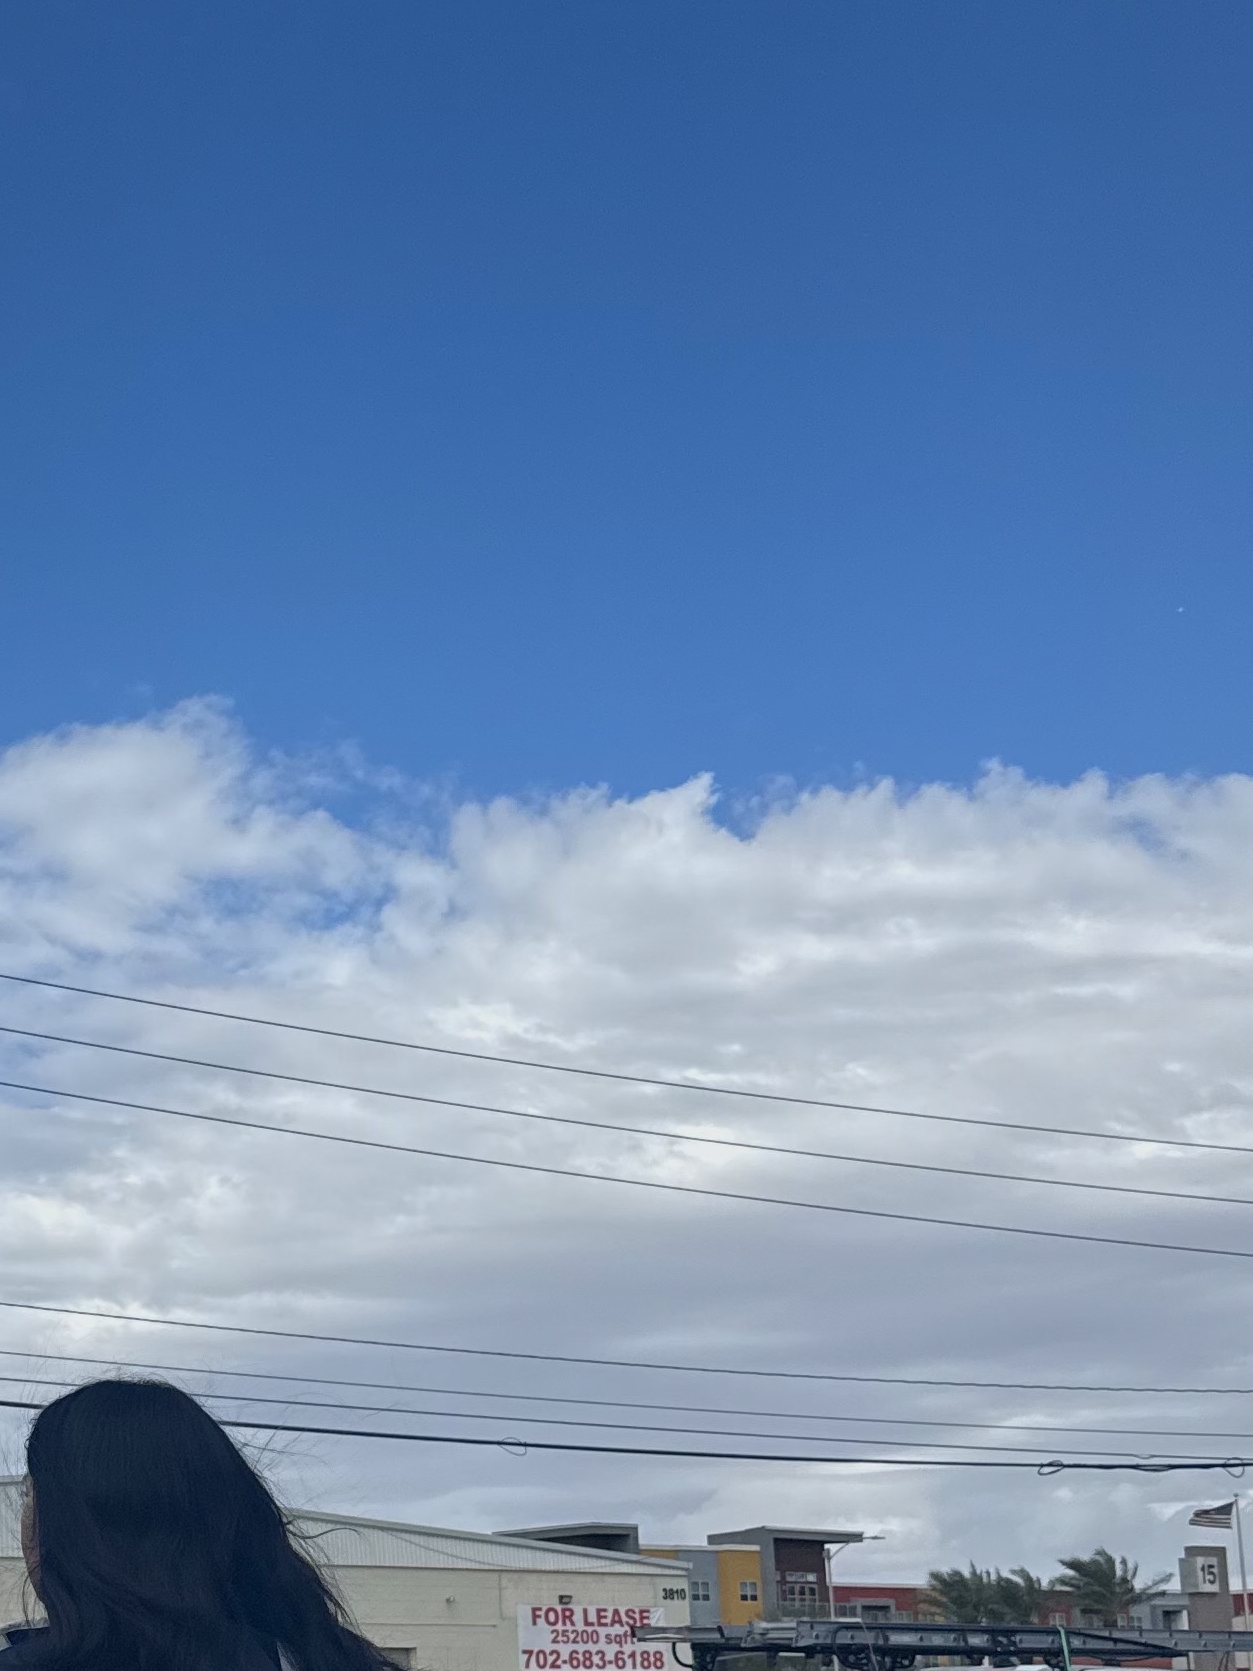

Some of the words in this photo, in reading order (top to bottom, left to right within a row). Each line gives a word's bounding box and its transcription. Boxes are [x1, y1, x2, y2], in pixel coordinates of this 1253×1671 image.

[1200, 1564, 1217, 1585] 15
[662, 1587, 686, 1600] 3810
[531, 1607, 575, 1627] FOR
[582, 1608, 651, 1628] LEASE
[550, 1629, 600, 1645] 25200
[522, 1649, 665, 1670] 702-683-6188
